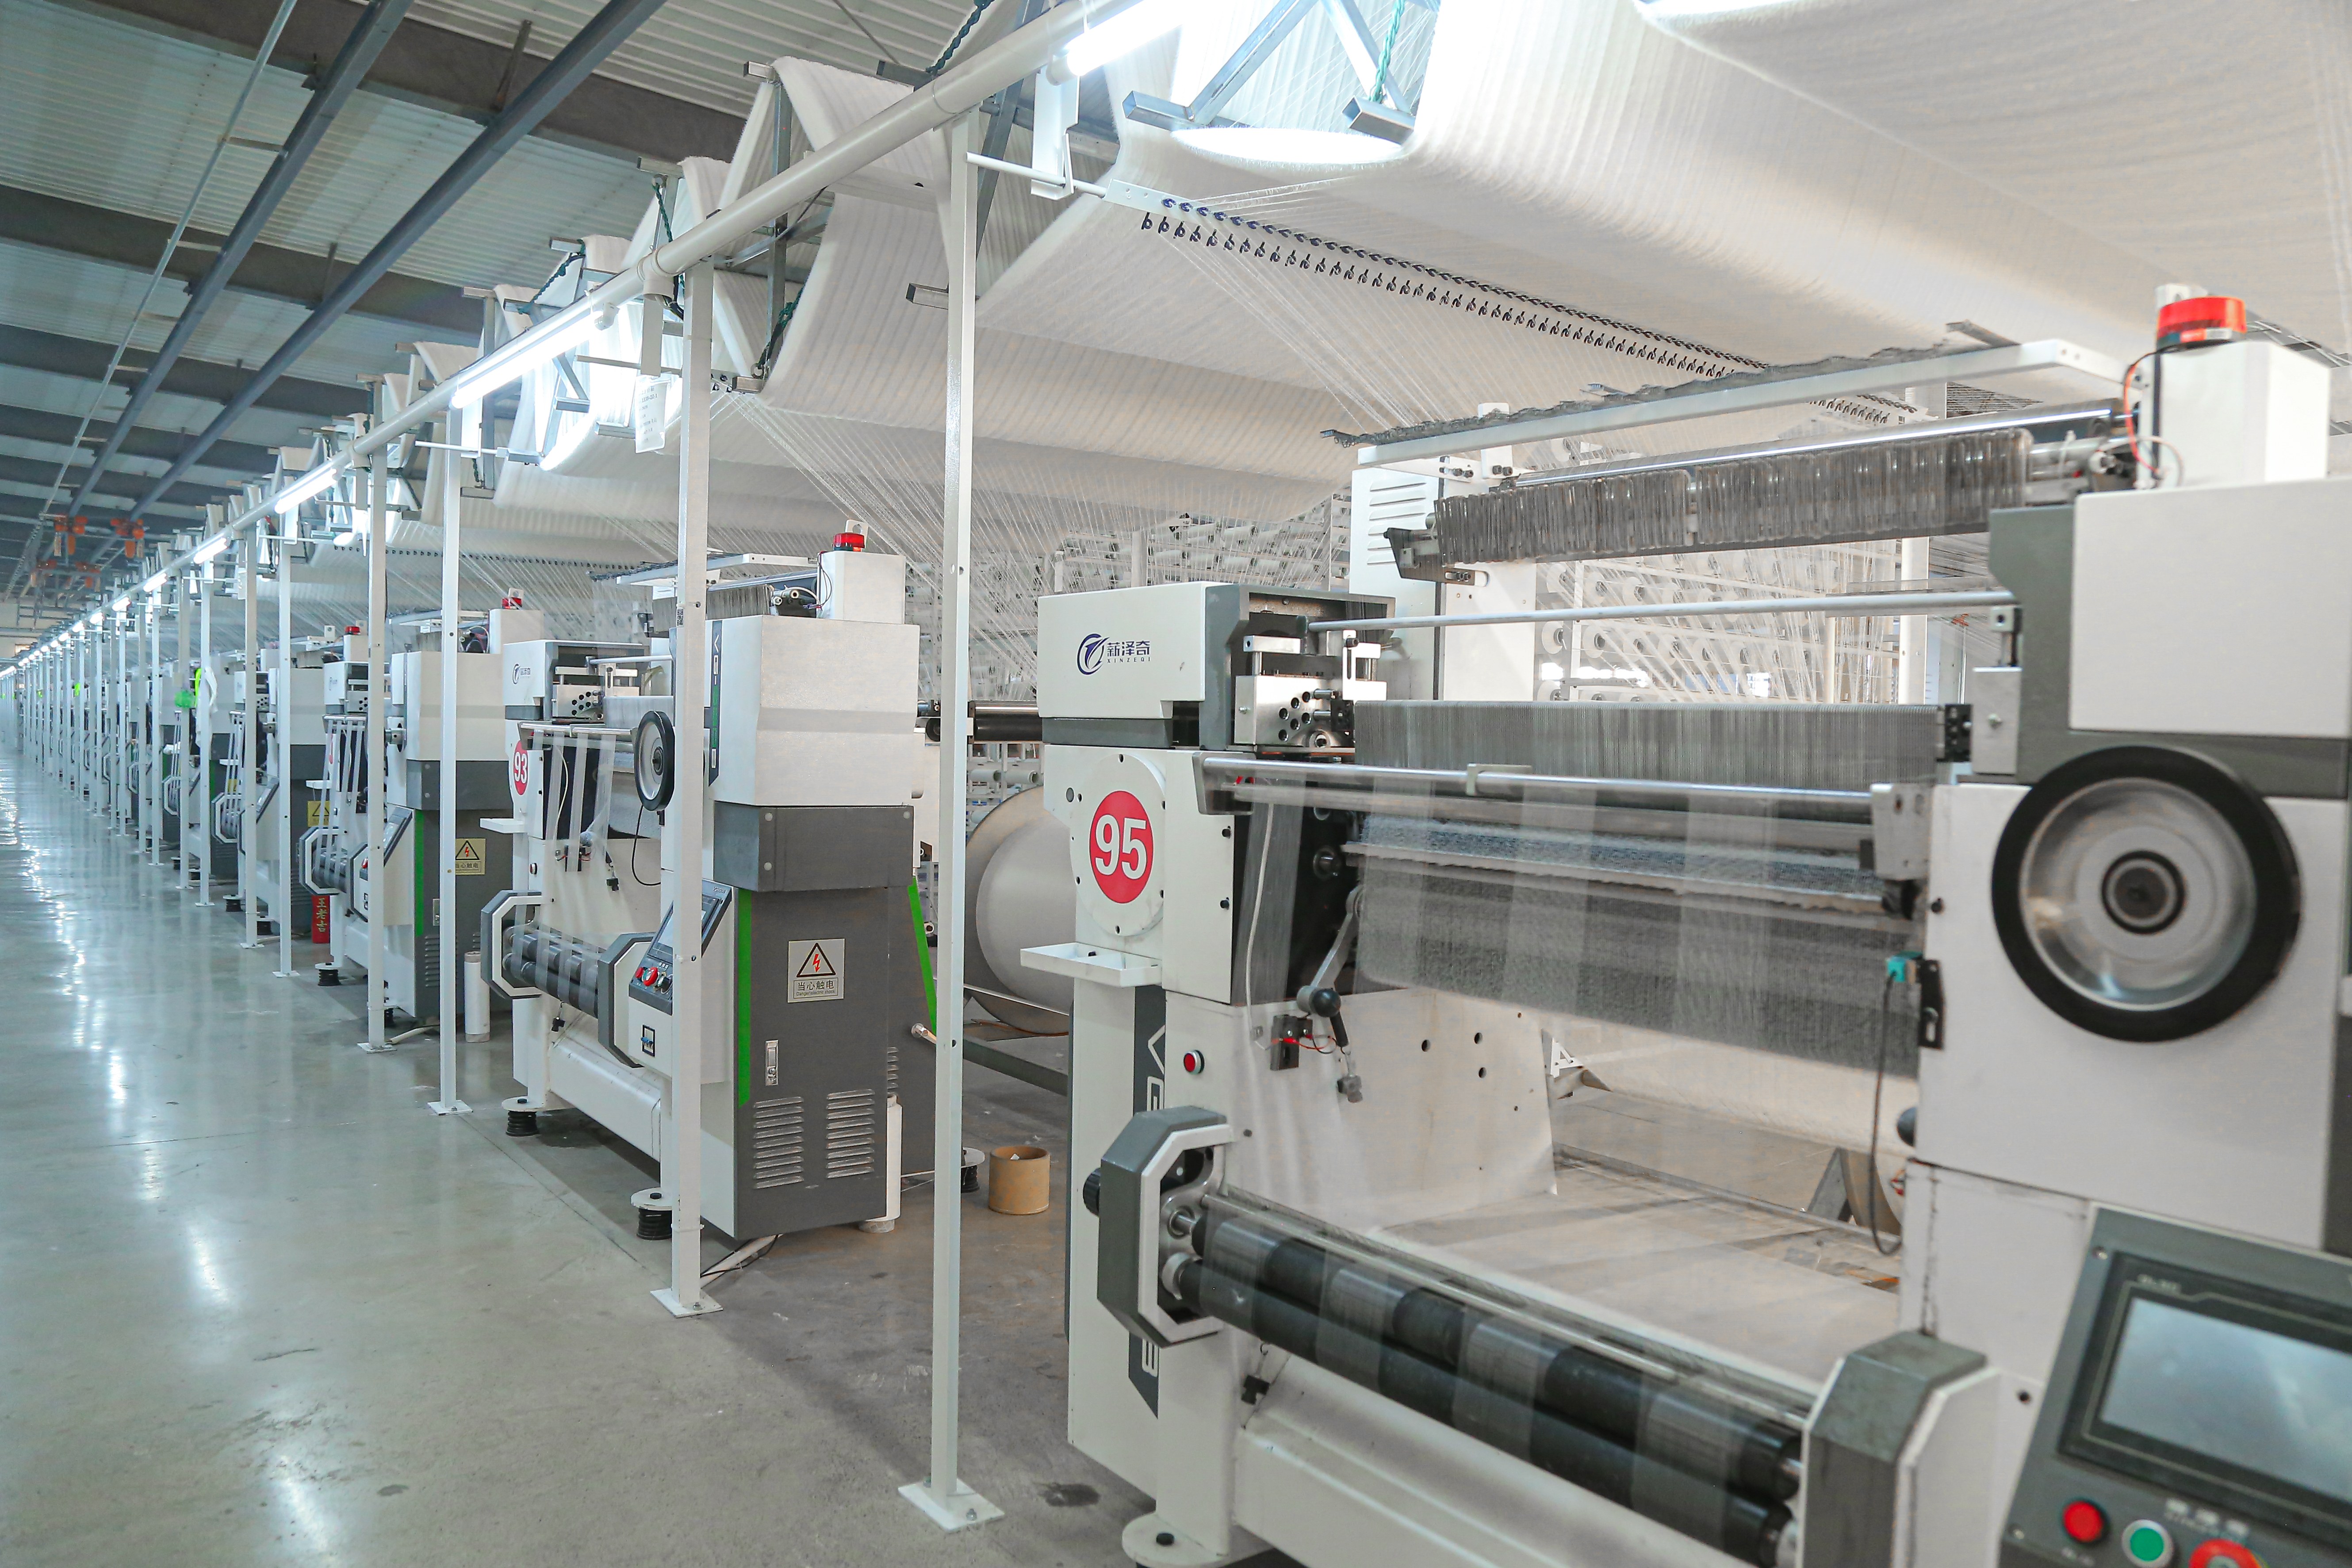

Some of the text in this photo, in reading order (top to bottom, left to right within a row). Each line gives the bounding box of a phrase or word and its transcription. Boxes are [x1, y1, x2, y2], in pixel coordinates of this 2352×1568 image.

[1107, 640, 1150, 657] 薪泽奇
[515, 751, 527, 784] 93
[1095, 814, 1147, 880] 95
[316, 897, 328, 933] 王老吉
[797, 980, 834, 991] 当心触电
